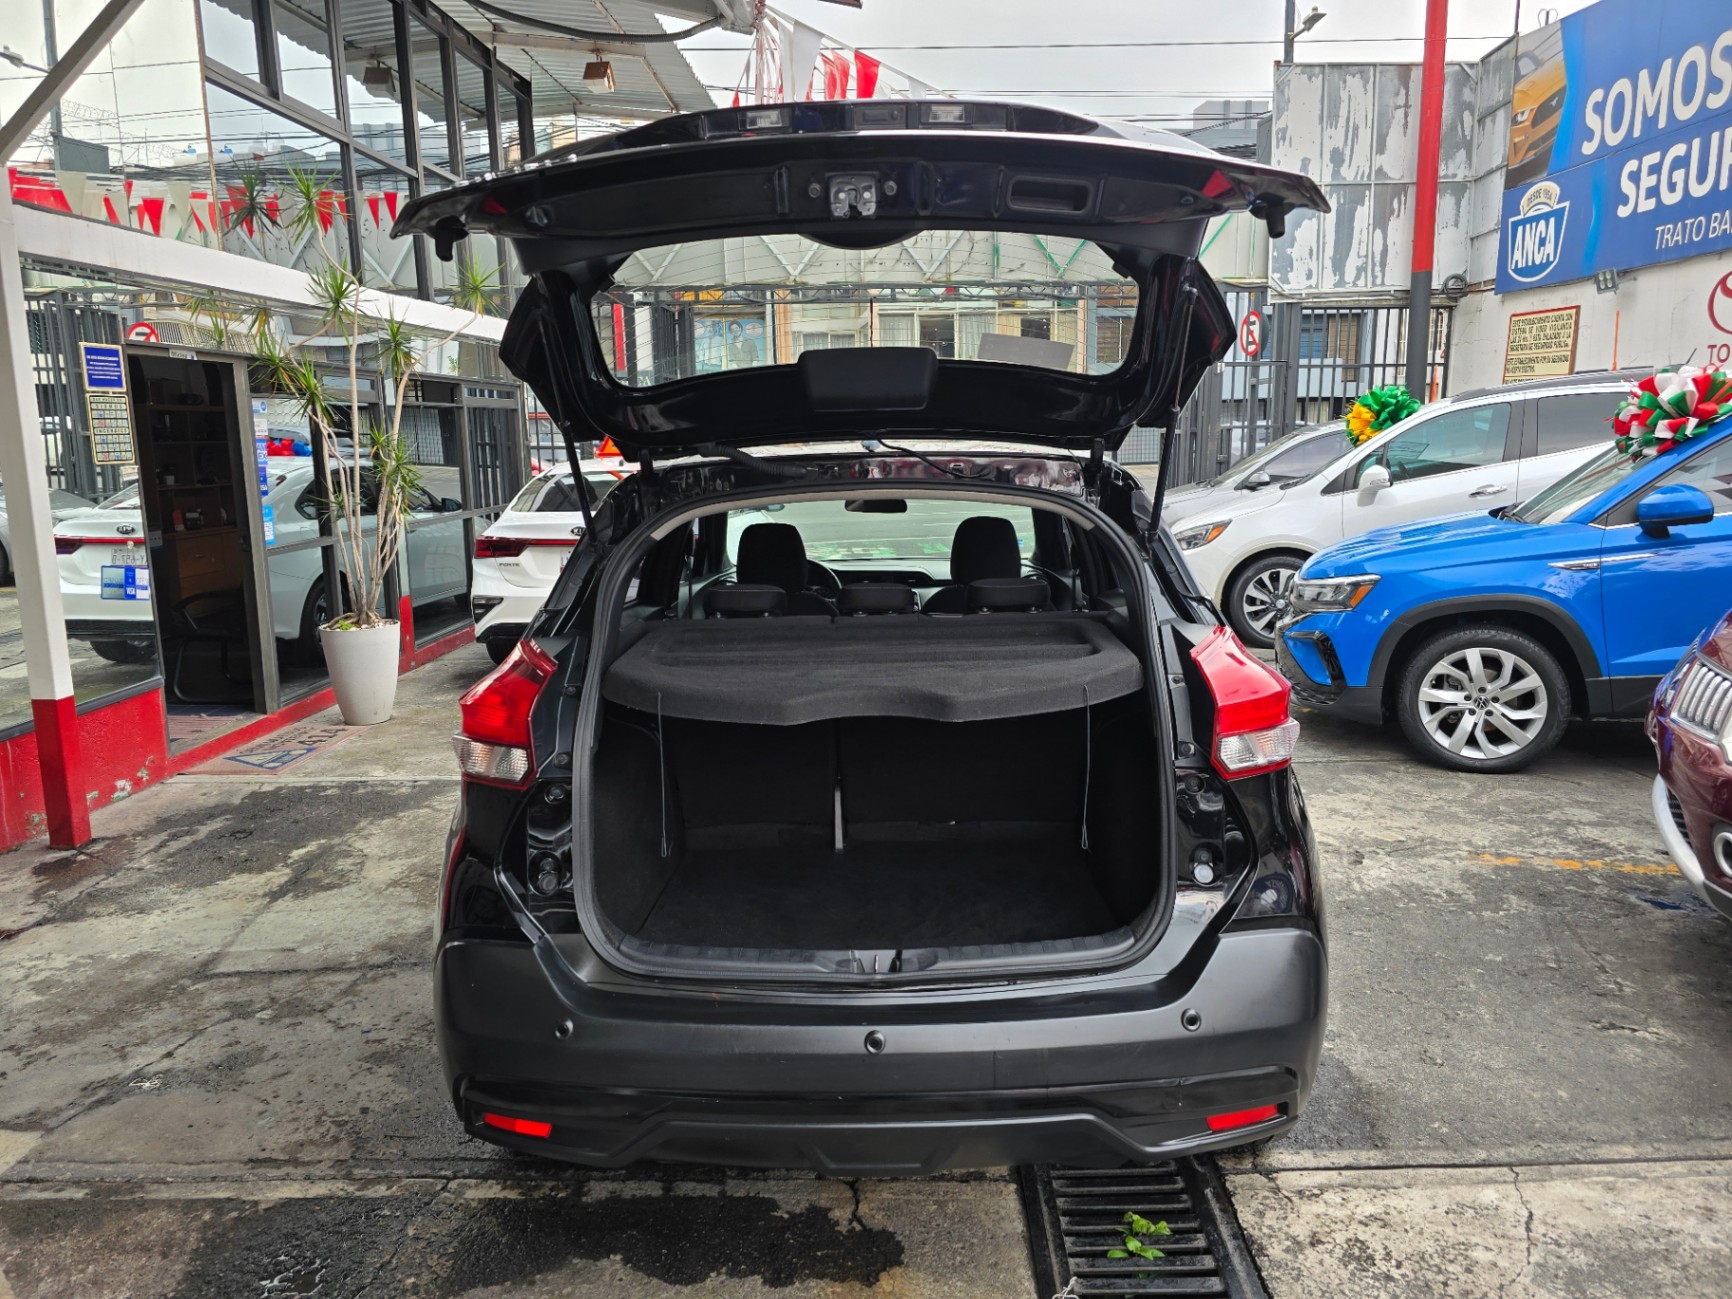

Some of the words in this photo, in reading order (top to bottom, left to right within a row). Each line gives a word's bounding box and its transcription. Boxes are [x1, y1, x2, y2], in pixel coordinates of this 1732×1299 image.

[1581, 30, 1732, 156] SOMOS
[1511, 216, 1555, 270] ANCA
[1655, 215, 1706, 250] TRATO
[1708, 209, 1732, 239] BA
